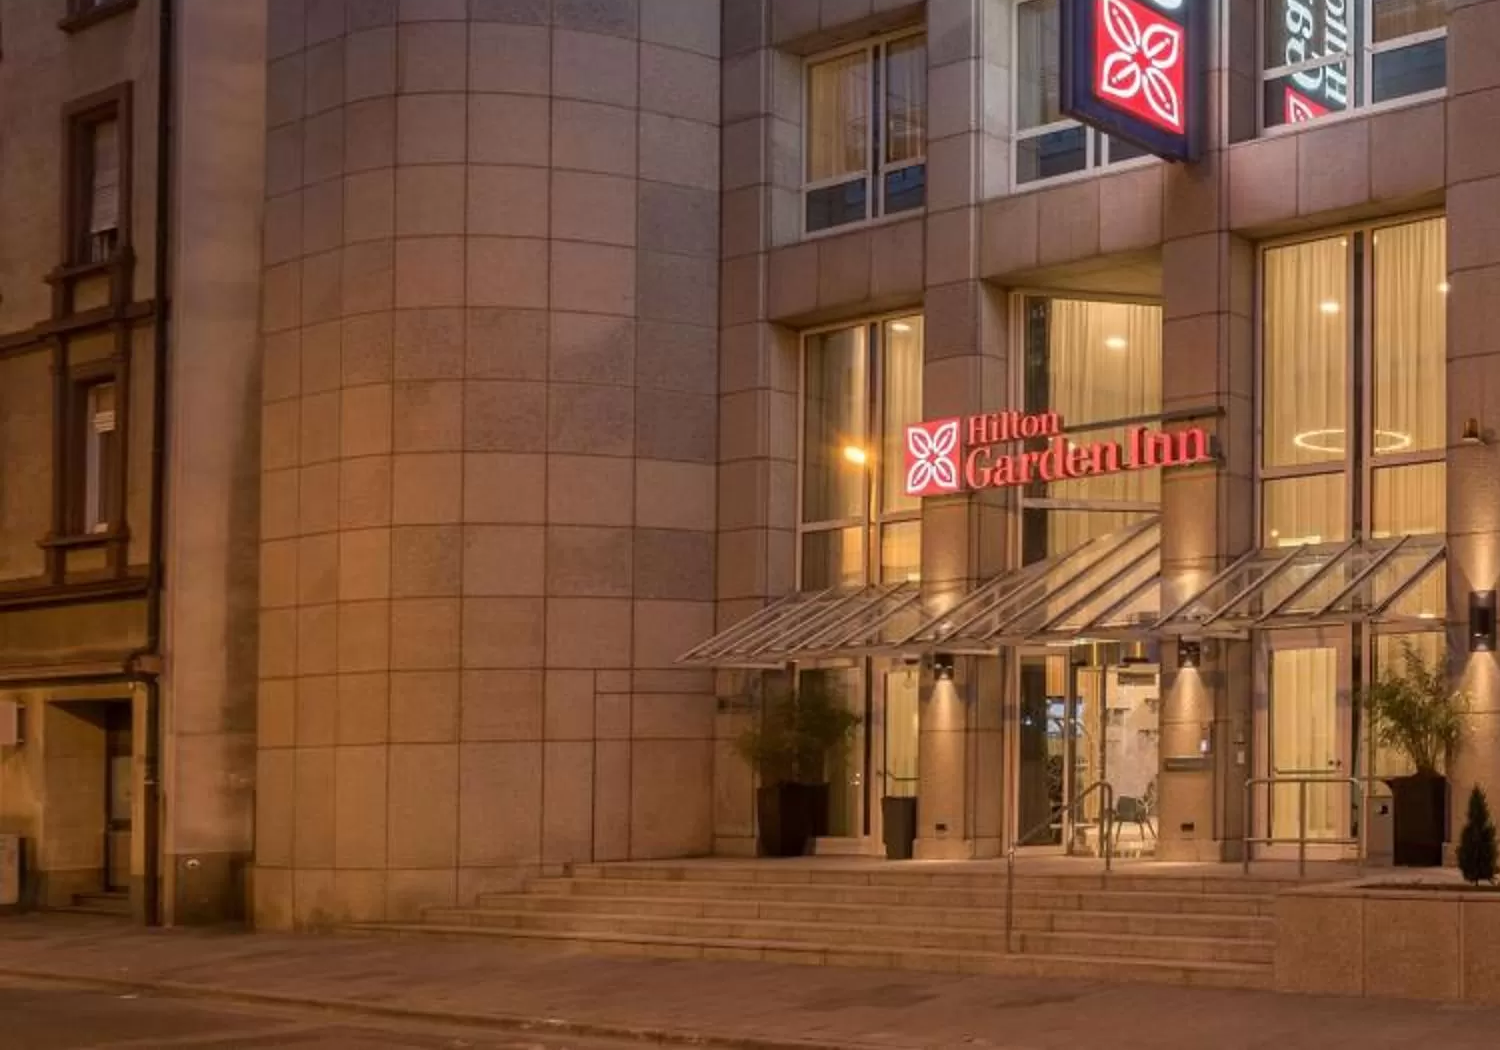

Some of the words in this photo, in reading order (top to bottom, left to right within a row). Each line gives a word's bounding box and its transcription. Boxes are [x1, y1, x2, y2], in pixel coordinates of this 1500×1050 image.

[968, 410, 1061, 446] Hilton
[965, 437, 1126, 489] Garden
[1123, 426, 1210, 469] Inn
